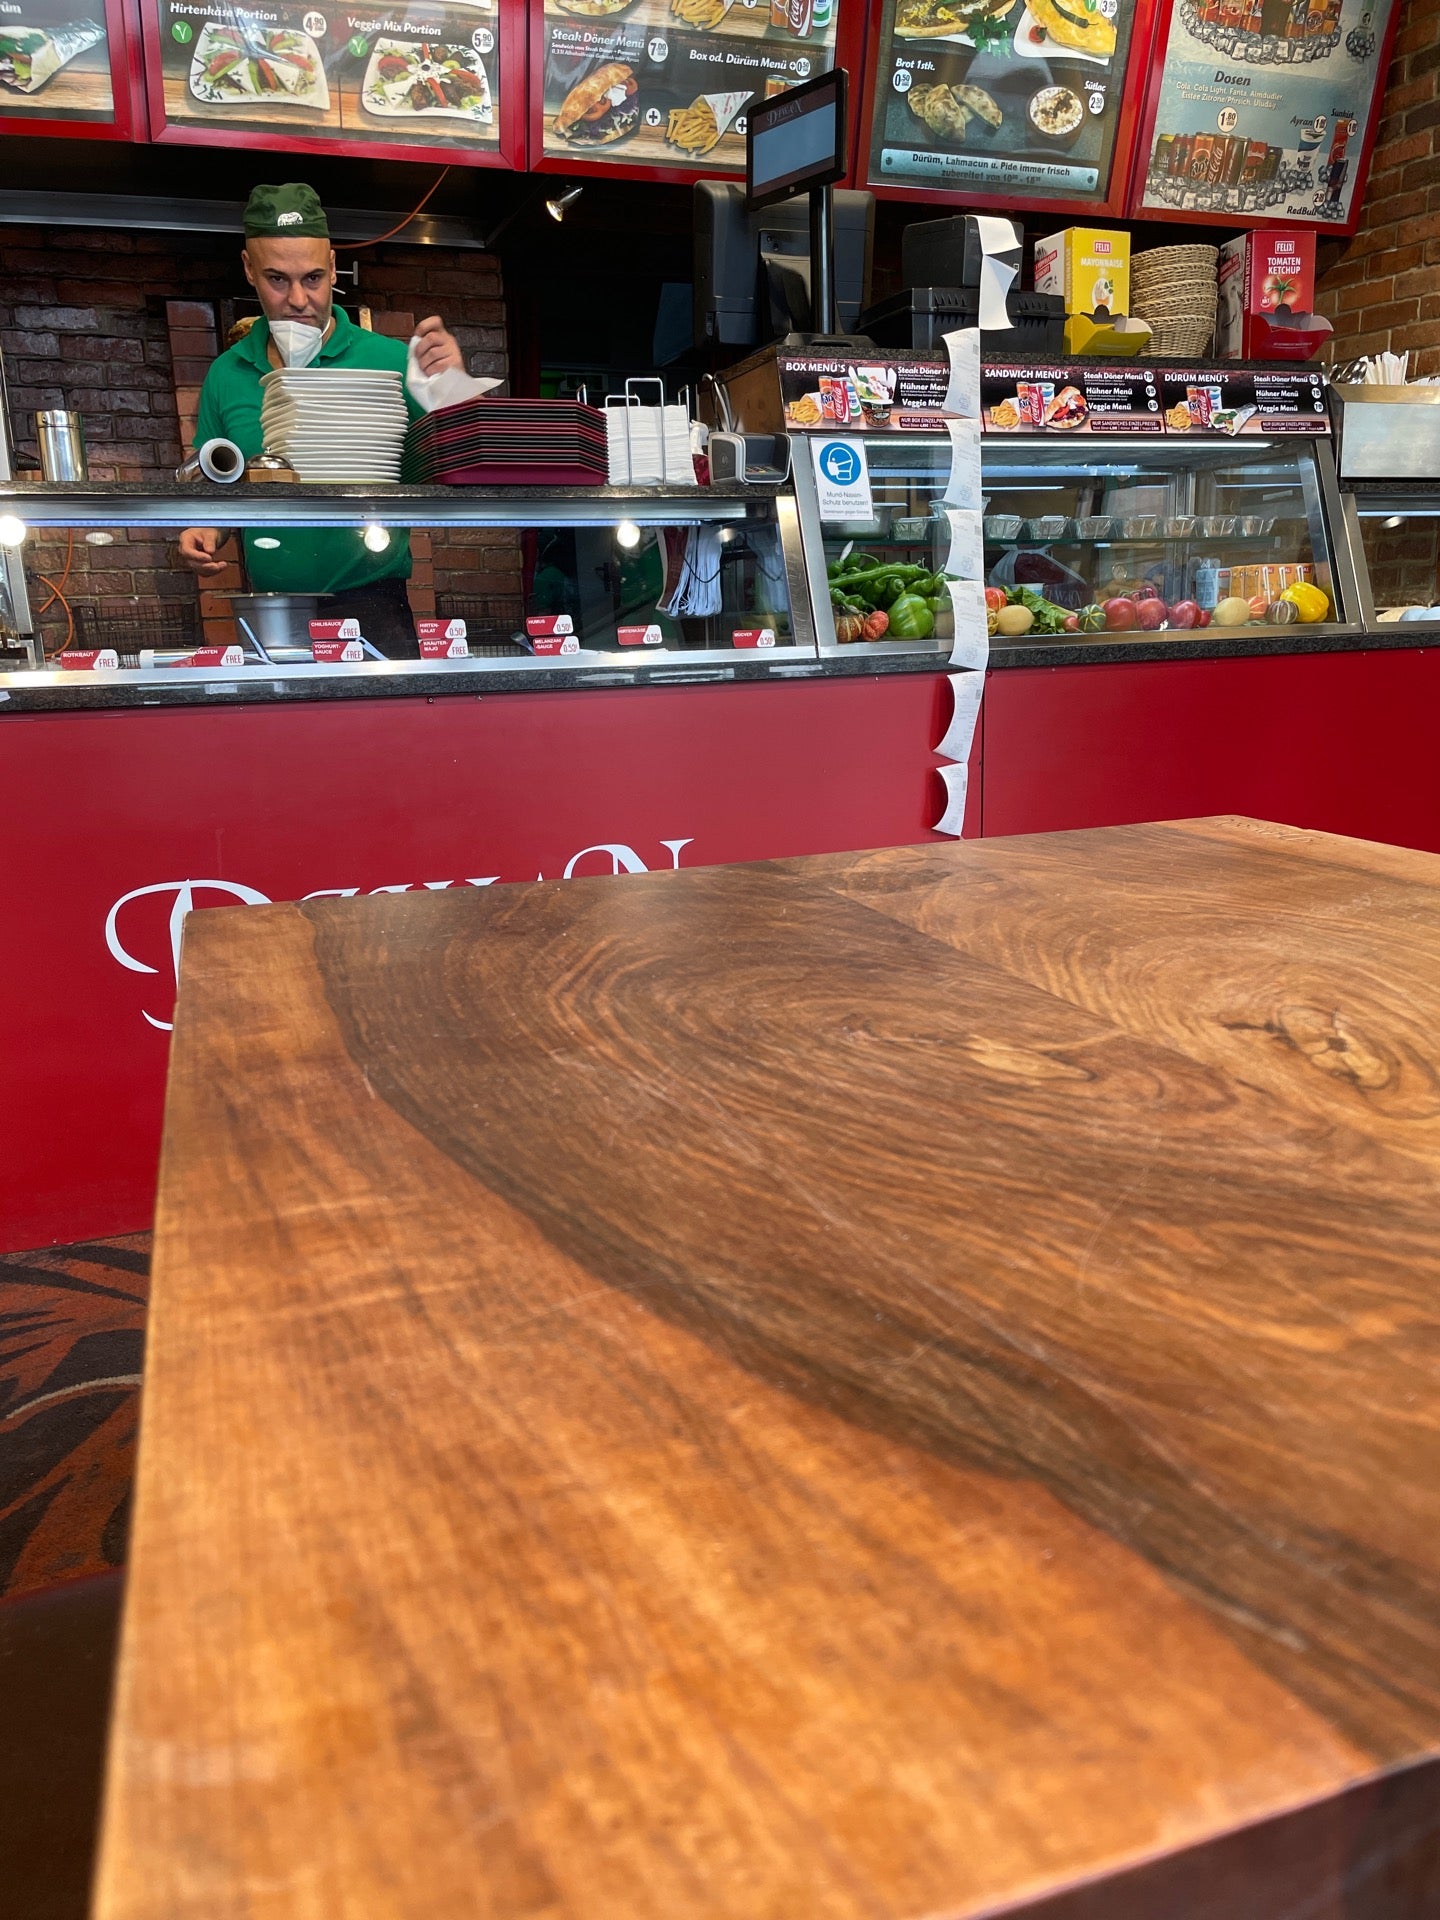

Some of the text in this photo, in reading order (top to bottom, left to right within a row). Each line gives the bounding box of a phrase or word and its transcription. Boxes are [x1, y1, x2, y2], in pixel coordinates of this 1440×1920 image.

[170, 3, 278, 21] Hirtenkäse Portion
[347, 17, 442, 36] Veggie Mix Portion
[552, 28, 645, 48] Steak Döner Menü
[690, 49, 787, 70] Box od. Dürüm Menü
[896, 57, 915, 68] Brot
[1214, 70, 1251, 86] Dosen
[1194, 84, 1208, 92] Cola
[1182, 91, 1201, 99] Eistee
[1290, 115, 1312, 127] Ayran
[912, 153, 943, 165] Dürüm,
[945, 157, 989, 169] Lahmacun
[1000, 161, 1018, 171] Pide
[1019, 164, 1046, 174] immer
[1047, 166, 1070, 176] frisch
[1287, 206, 1317, 216] RedBull
[1095, 243, 1110, 252] FELIX
[1276, 243, 1293, 252] FELIX
[1081, 257, 1123, 268] MAYONNAISE
[1267, 257, 1301, 266] TOMATEN
[1268, 266, 1301, 275] KETCHUP
[786, 362, 807, 371] BOX
[898, 366, 919, 374] Steak
[919, 366, 941, 375] Döner
[985, 368, 1033, 378] SANDWICH
[1083, 371, 1103, 379] Steak
[1103, 372, 1123, 380] Döner
[1165, 372, 1197, 382] DÜRÜM
[1271, 375, 1290, 383] Döner
[900, 382, 928, 390] Hühner
[1086, 387, 1133, 395] Hühner Menü
[1256, 389, 1280, 397] Hühner
[901, 398, 927, 408] Veggie
[1088, 402, 1132, 411] Veggie Menü
[1258, 404, 1279, 413] Veggie
[343, 628, 358, 637] FREE
[346, 650, 361, 659] FREE
[452, 647, 466, 655] FREE
[99, 658, 115, 668] FREE
[226, 654, 242, 664] FREE
